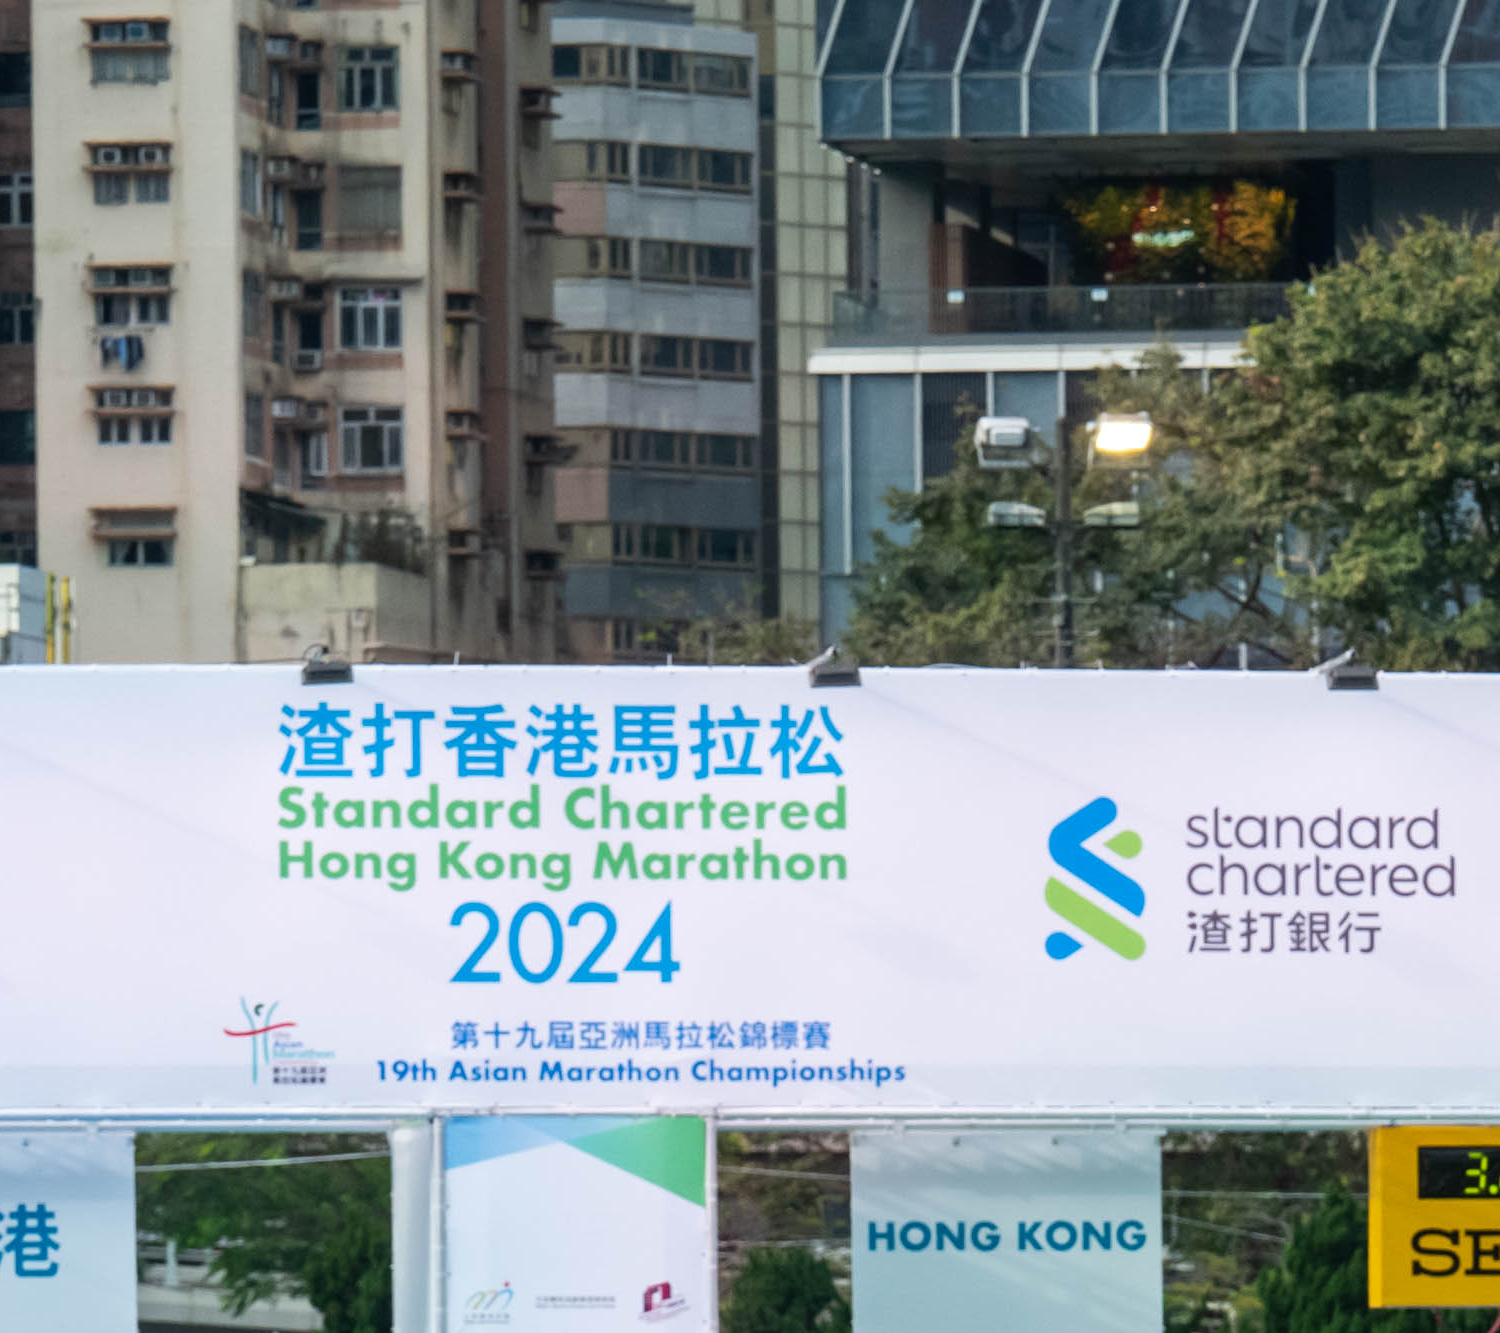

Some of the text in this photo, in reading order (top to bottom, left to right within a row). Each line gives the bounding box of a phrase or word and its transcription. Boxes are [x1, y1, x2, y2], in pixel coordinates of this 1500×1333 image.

[279, 702, 843, 779] 渣打香港馬拉松
[278, 784, 846, 830] Standard Chartered
[1186, 807, 1438, 850] standard
[279, 838, 847, 892] Hong Kong Marathon
[1187, 853, 1455, 897] chartered
[450, 902, 680, 984] 2024
[1188, 910, 1381, 954] 渣打銀行
[452, 1021, 830, 1050] 第十九屆亞洲馬拉松錦標賽
[378, 1059, 905, 1087] 19th Asian Marathon Championships
[868, 1220, 1146, 1252] HONG KONG
